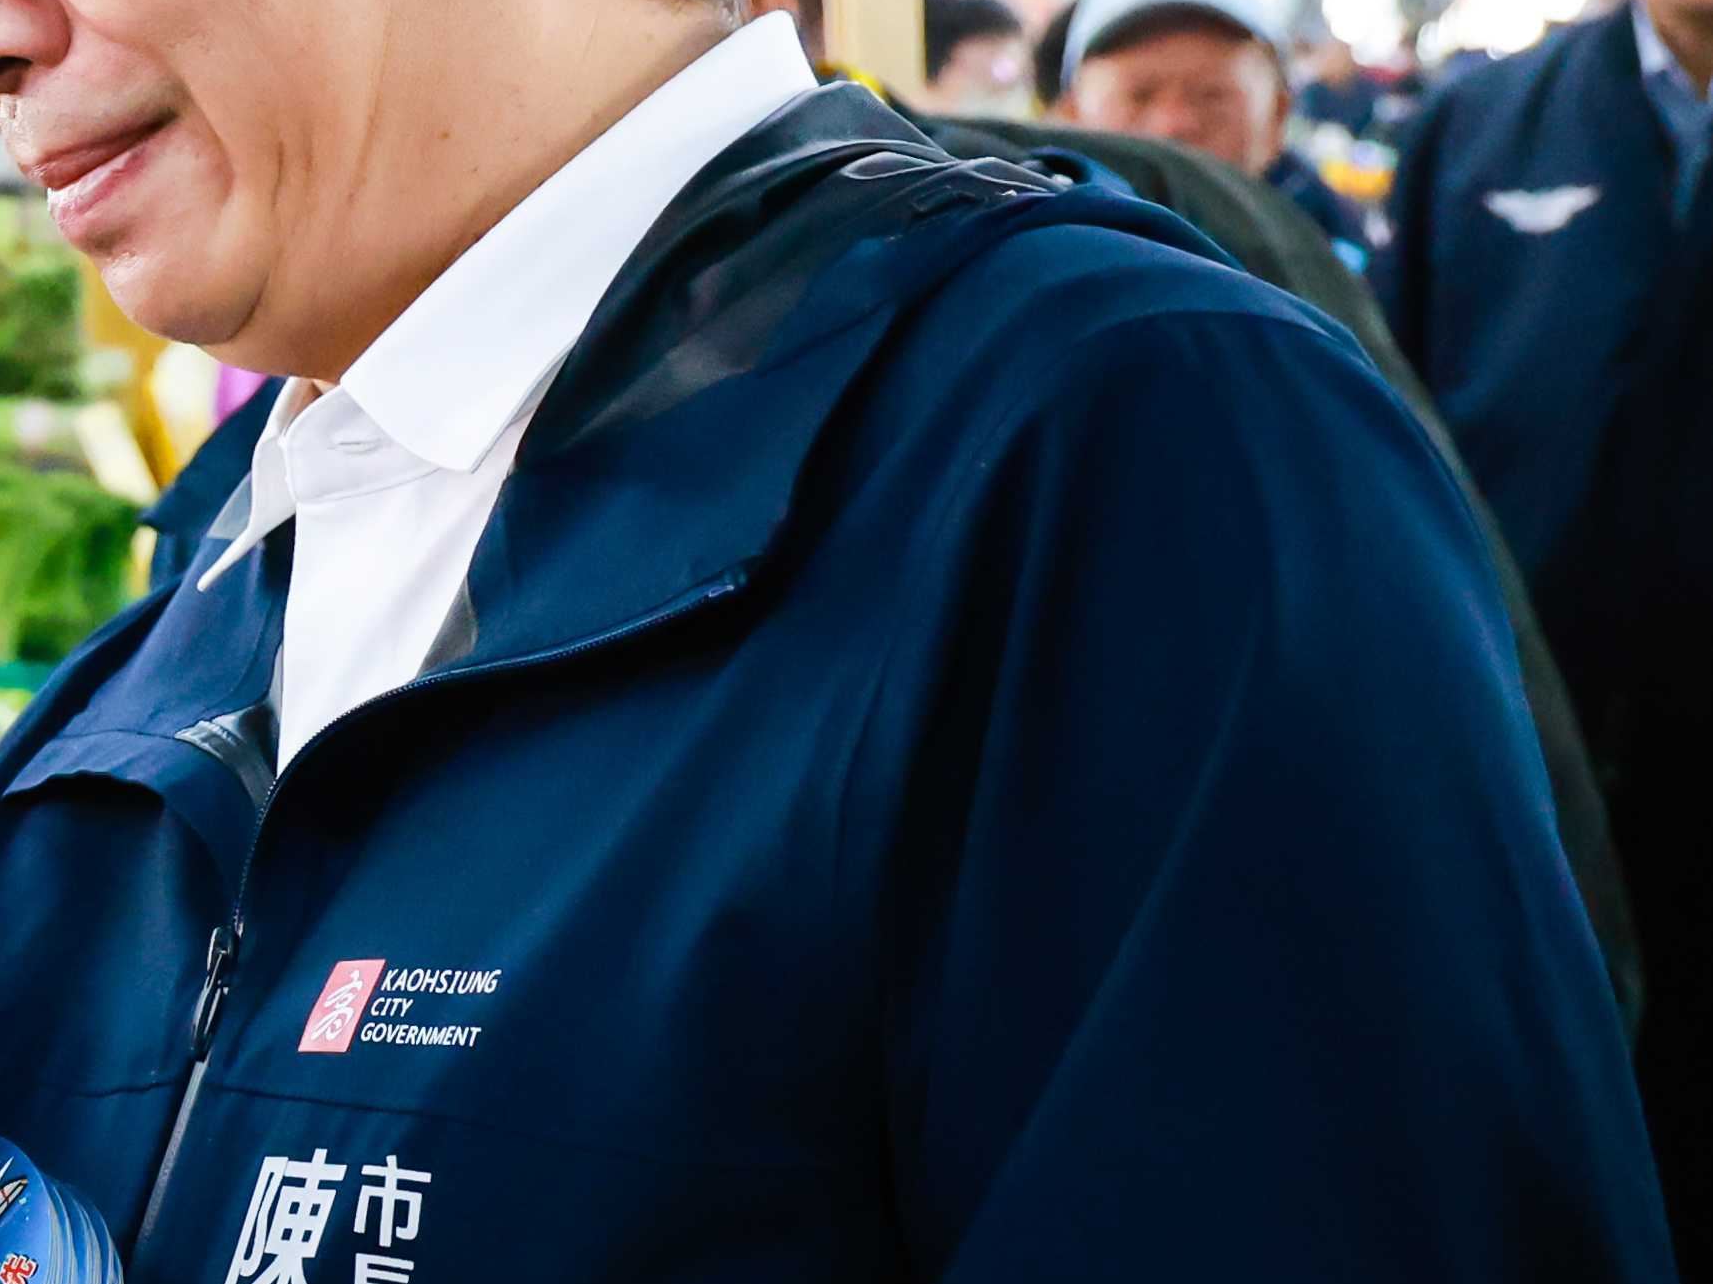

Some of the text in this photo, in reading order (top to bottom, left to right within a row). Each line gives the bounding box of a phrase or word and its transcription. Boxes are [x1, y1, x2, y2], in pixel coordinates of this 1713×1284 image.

[380, 968, 502, 994] KAOHSIUNG
[370, 997, 414, 1017] CITY
[360, 1022, 481, 1047] GOVERNMENT
